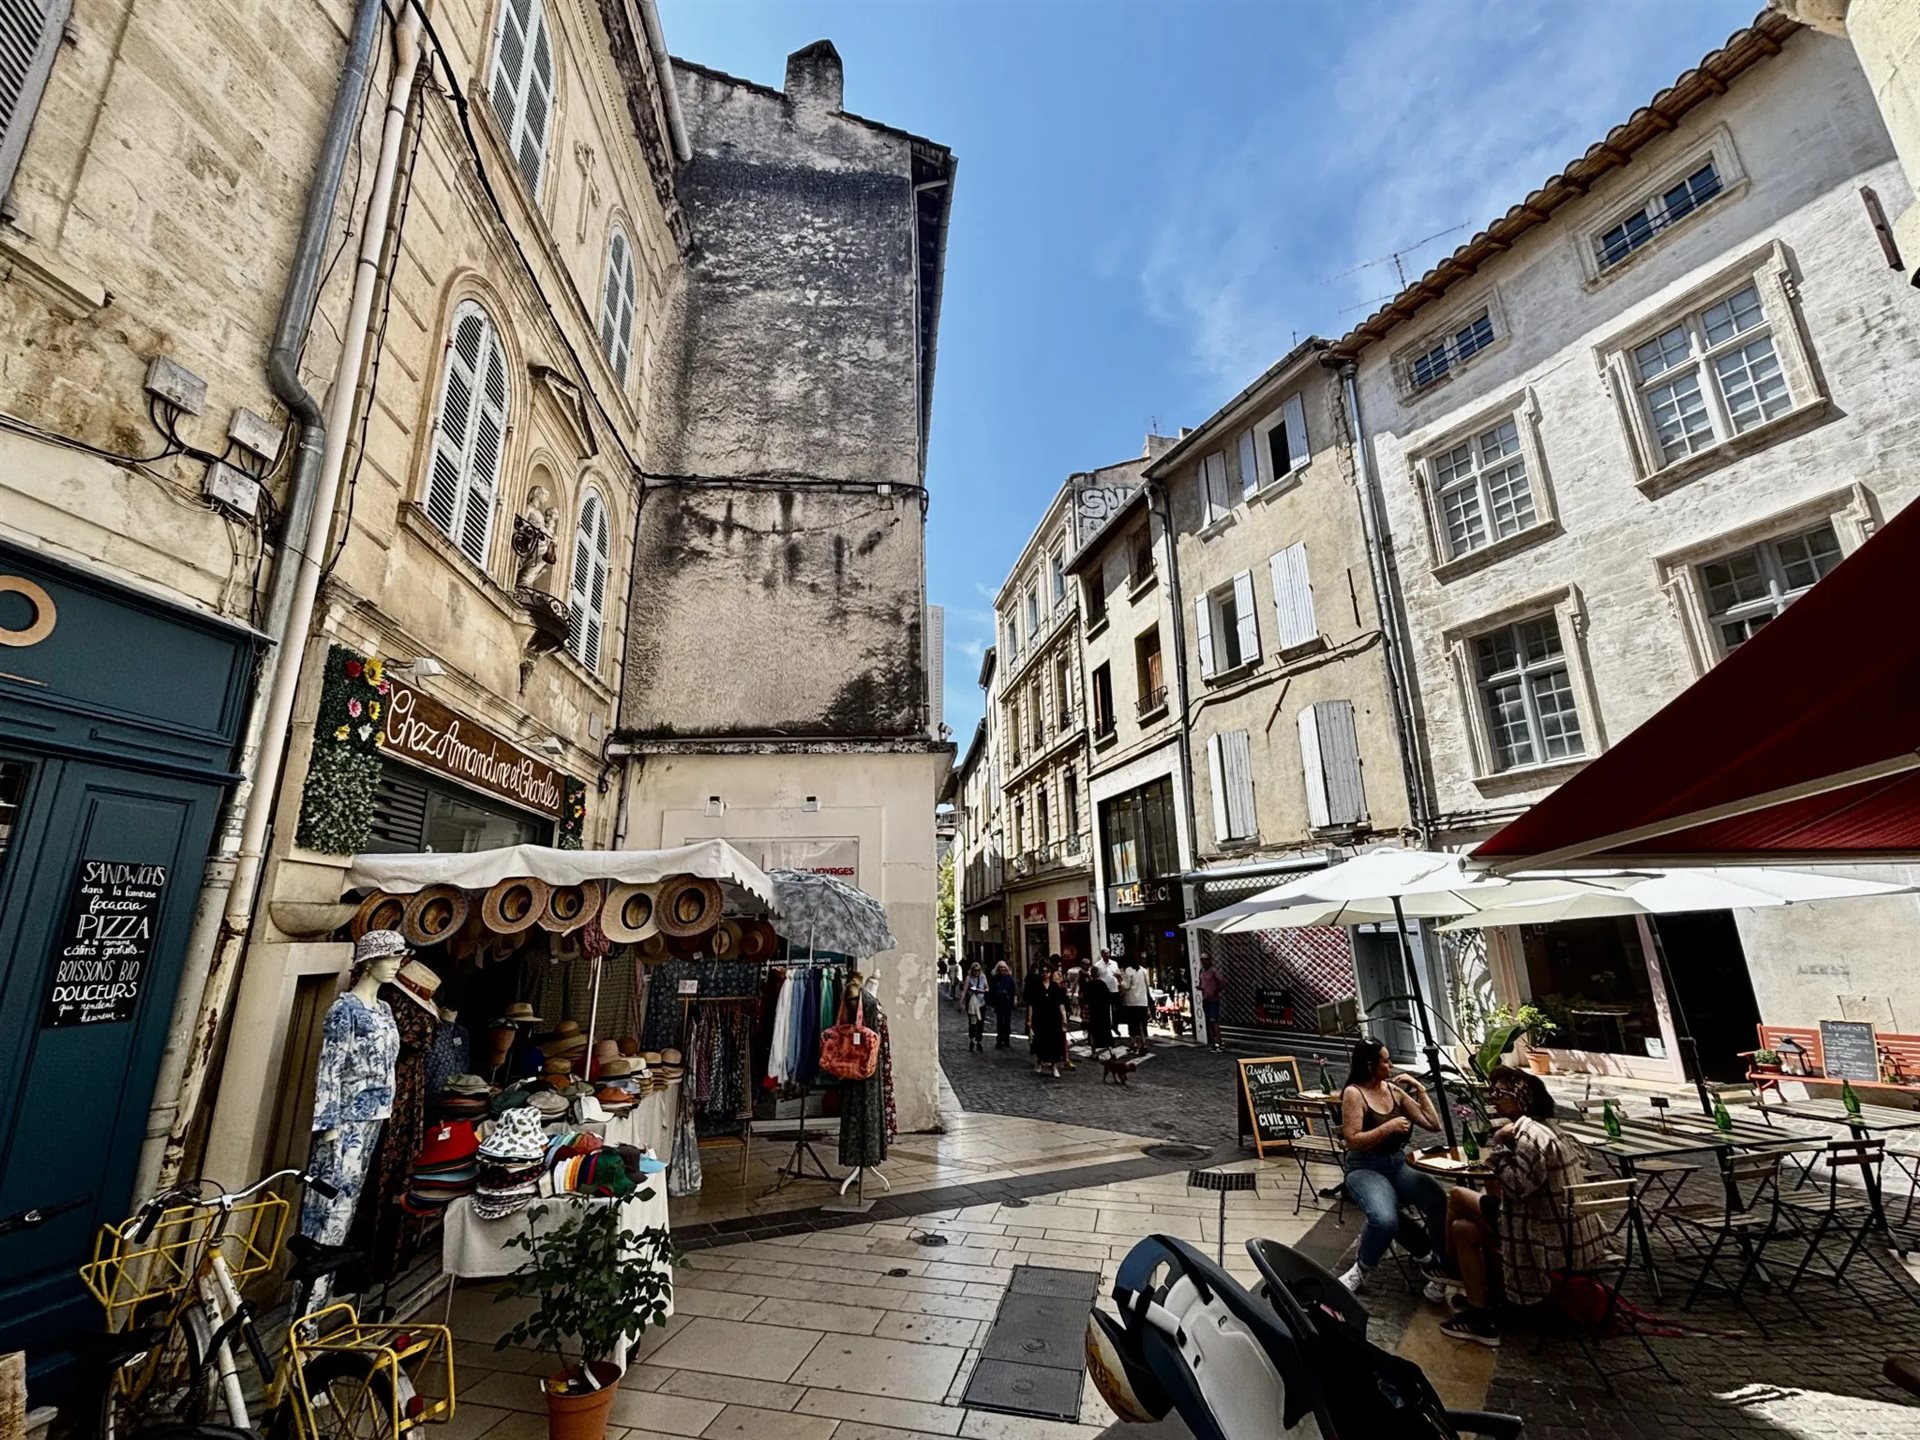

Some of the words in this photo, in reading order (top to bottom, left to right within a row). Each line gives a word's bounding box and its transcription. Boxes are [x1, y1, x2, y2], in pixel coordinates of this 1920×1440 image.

[387, 684, 439, 755] Chez
[436, 720, 512, 787] Amandine
[519, 758, 559, 809] Charles
[81, 884, 104, 894] dans
[113, 885, 122, 896] la
[125, 885, 157, 898] fameuse
[89, 895, 148, 914] focaccia
[76, 914, 150, 939] PIZZA
[56, 960, 116, 982] BOISSONS
[119, 960, 140, 981] BIO
[52, 982, 138, 1002] DOUCEURS
[59, 1004, 75, 1017] qui
[80, 998, 117, 1010] rendent
